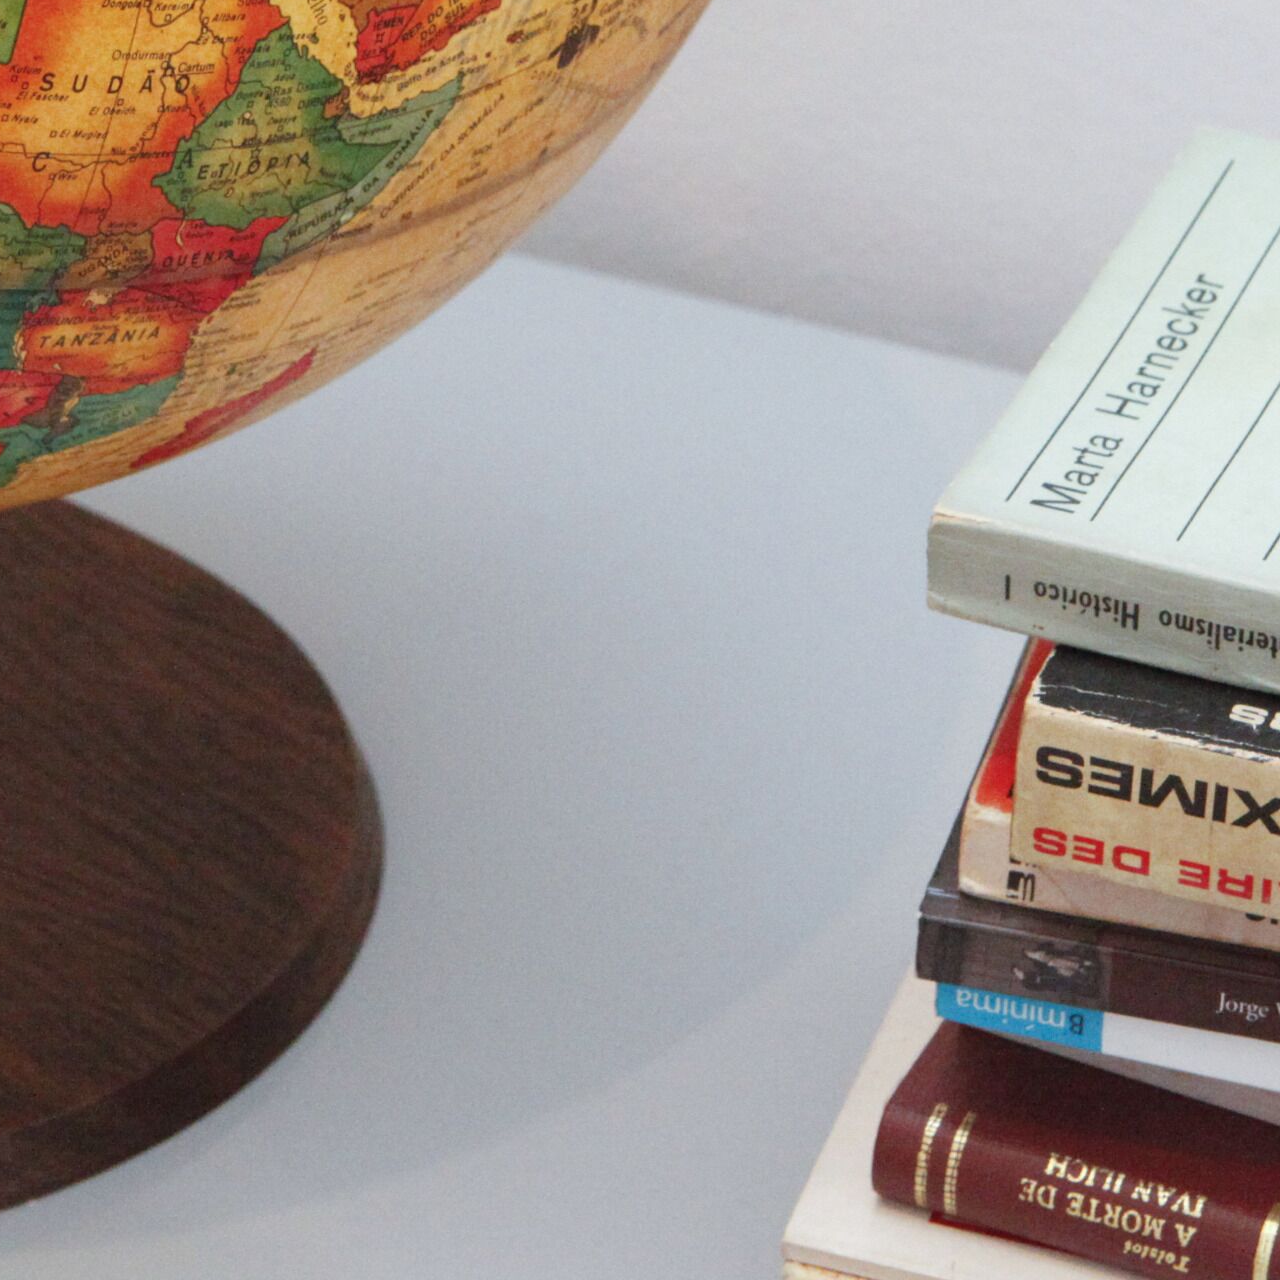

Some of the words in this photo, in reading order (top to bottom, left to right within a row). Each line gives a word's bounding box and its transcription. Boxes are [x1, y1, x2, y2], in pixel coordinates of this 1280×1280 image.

[40, 68, 191, 94] SUDÃO
[1030, 431, 1124, 514] Marta
[1096, 272, 1223, 420] Harnecker
[1033, 580, 1139, 631] Histórico
[1032, 827, 1151, 876] DES
[956, 988, 1066, 1031] mínima
[1216, 992, 1269, 1021] Jorge
[1018, 1176, 1057, 1209] DE
[1045, 1152, 1126, 1194] ILICH
[1065, 1195, 1166, 1241] MORTE
[1132, 1179, 1207, 1218] IVAN
[1175, 1223, 1197, 1247] A
